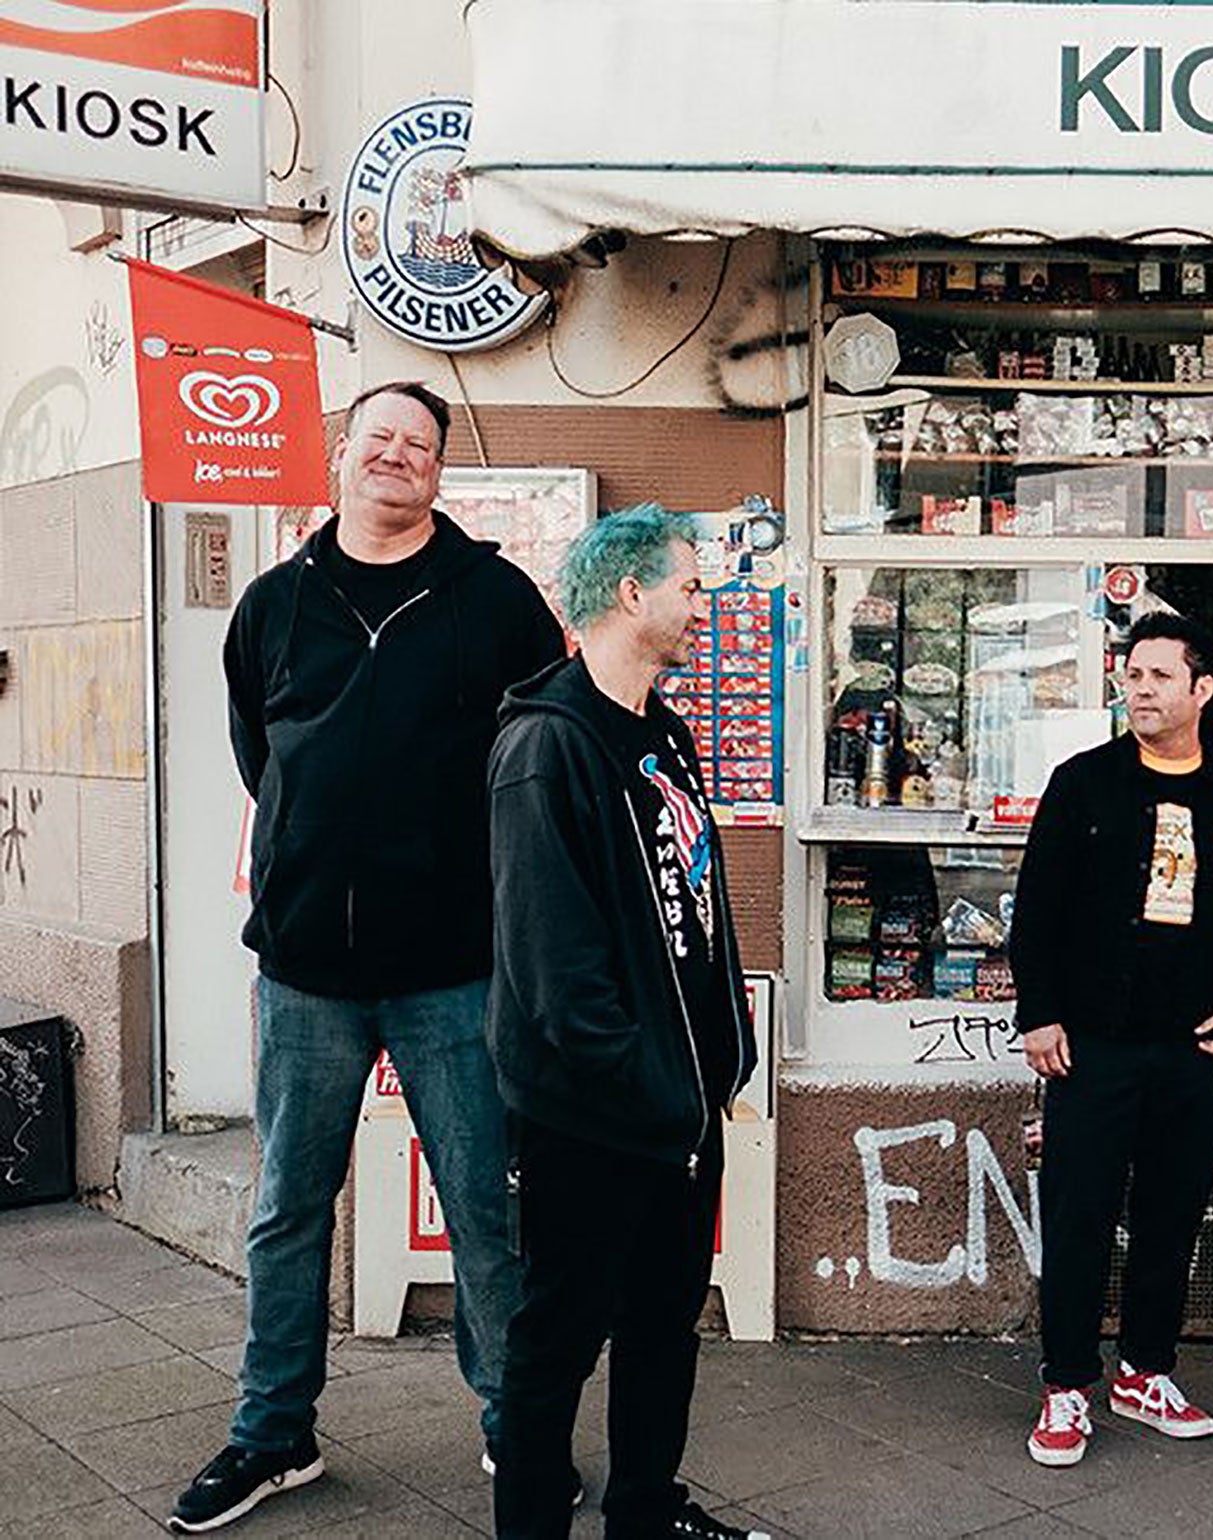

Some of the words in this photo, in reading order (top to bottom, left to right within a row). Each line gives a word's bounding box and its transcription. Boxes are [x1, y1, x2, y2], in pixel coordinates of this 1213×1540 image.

[5, 77, 217, 156] KIOSK
[364, 264, 515, 333] PILSENER
[185, 430, 281, 448] LANGNESE
